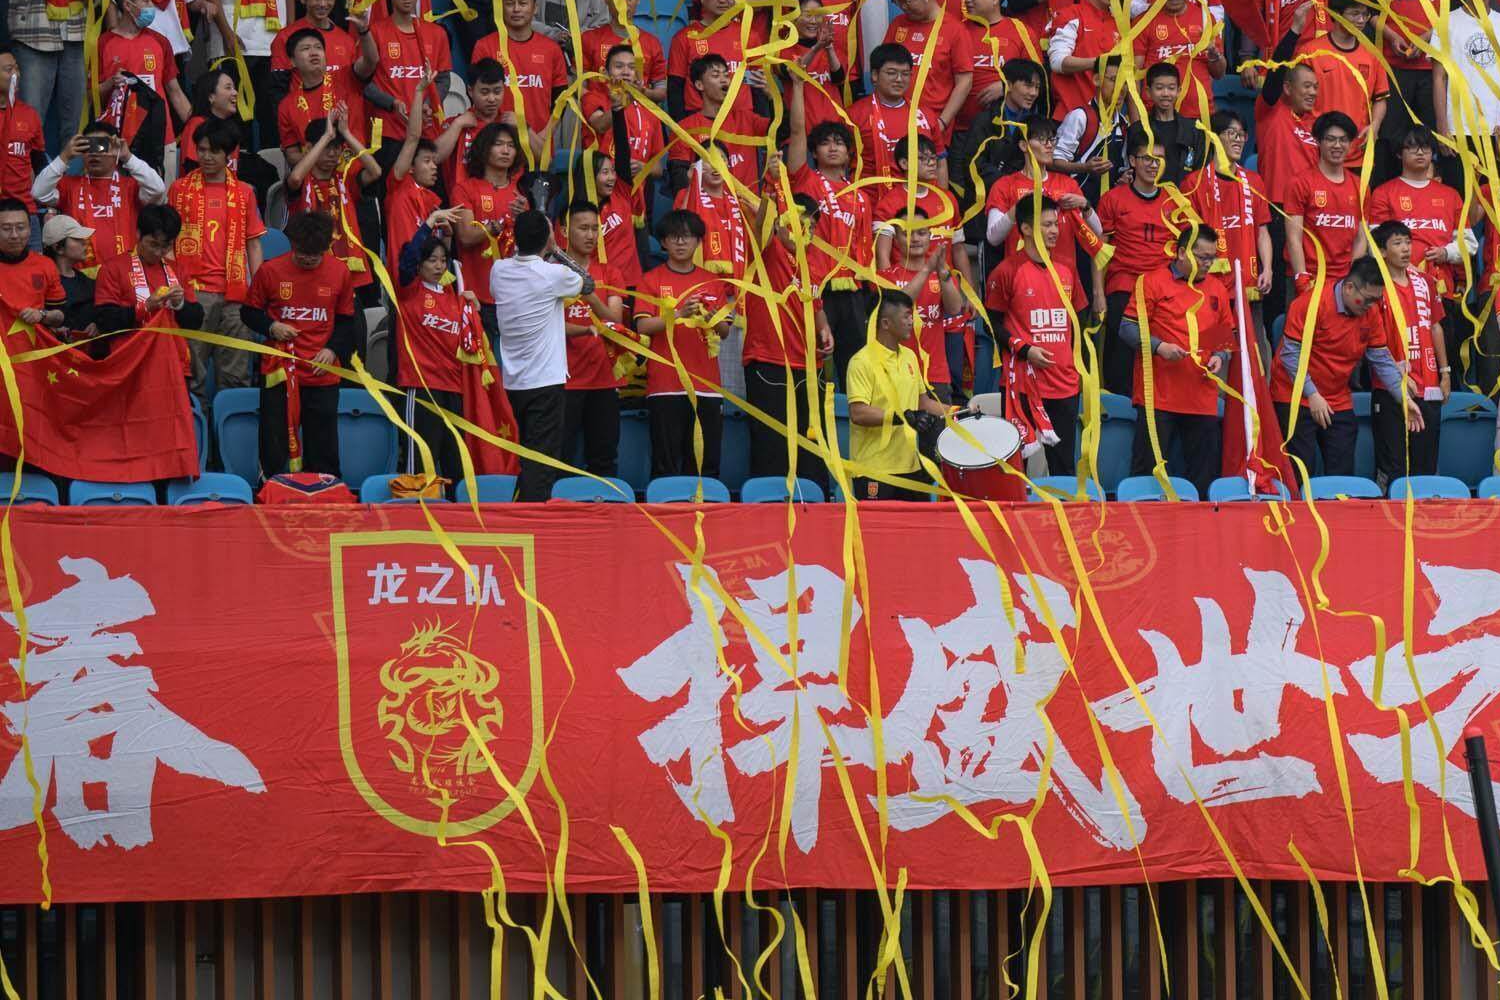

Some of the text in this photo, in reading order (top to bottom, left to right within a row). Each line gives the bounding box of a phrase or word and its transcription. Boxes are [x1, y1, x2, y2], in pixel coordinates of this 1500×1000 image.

[973, 54, 1005, 68] 之队
[1294, 128, 1318, 146] 龙之
[601, 215, 623, 235] 之队
[1316, 214, 1355, 229] 龙之队
[1401, 218, 1446, 232] 龙之队
[1144, 223, 1156, 241] 11
[281, 306, 327, 321] 龙之队
[568, 304, 590, 318] 龙之
[1030, 309, 1067, 328] 中国
[1033, 333, 1066, 343] CHINA
[367, 562, 506, 606] 龙之队
[0, 556, 268, 851] 春
